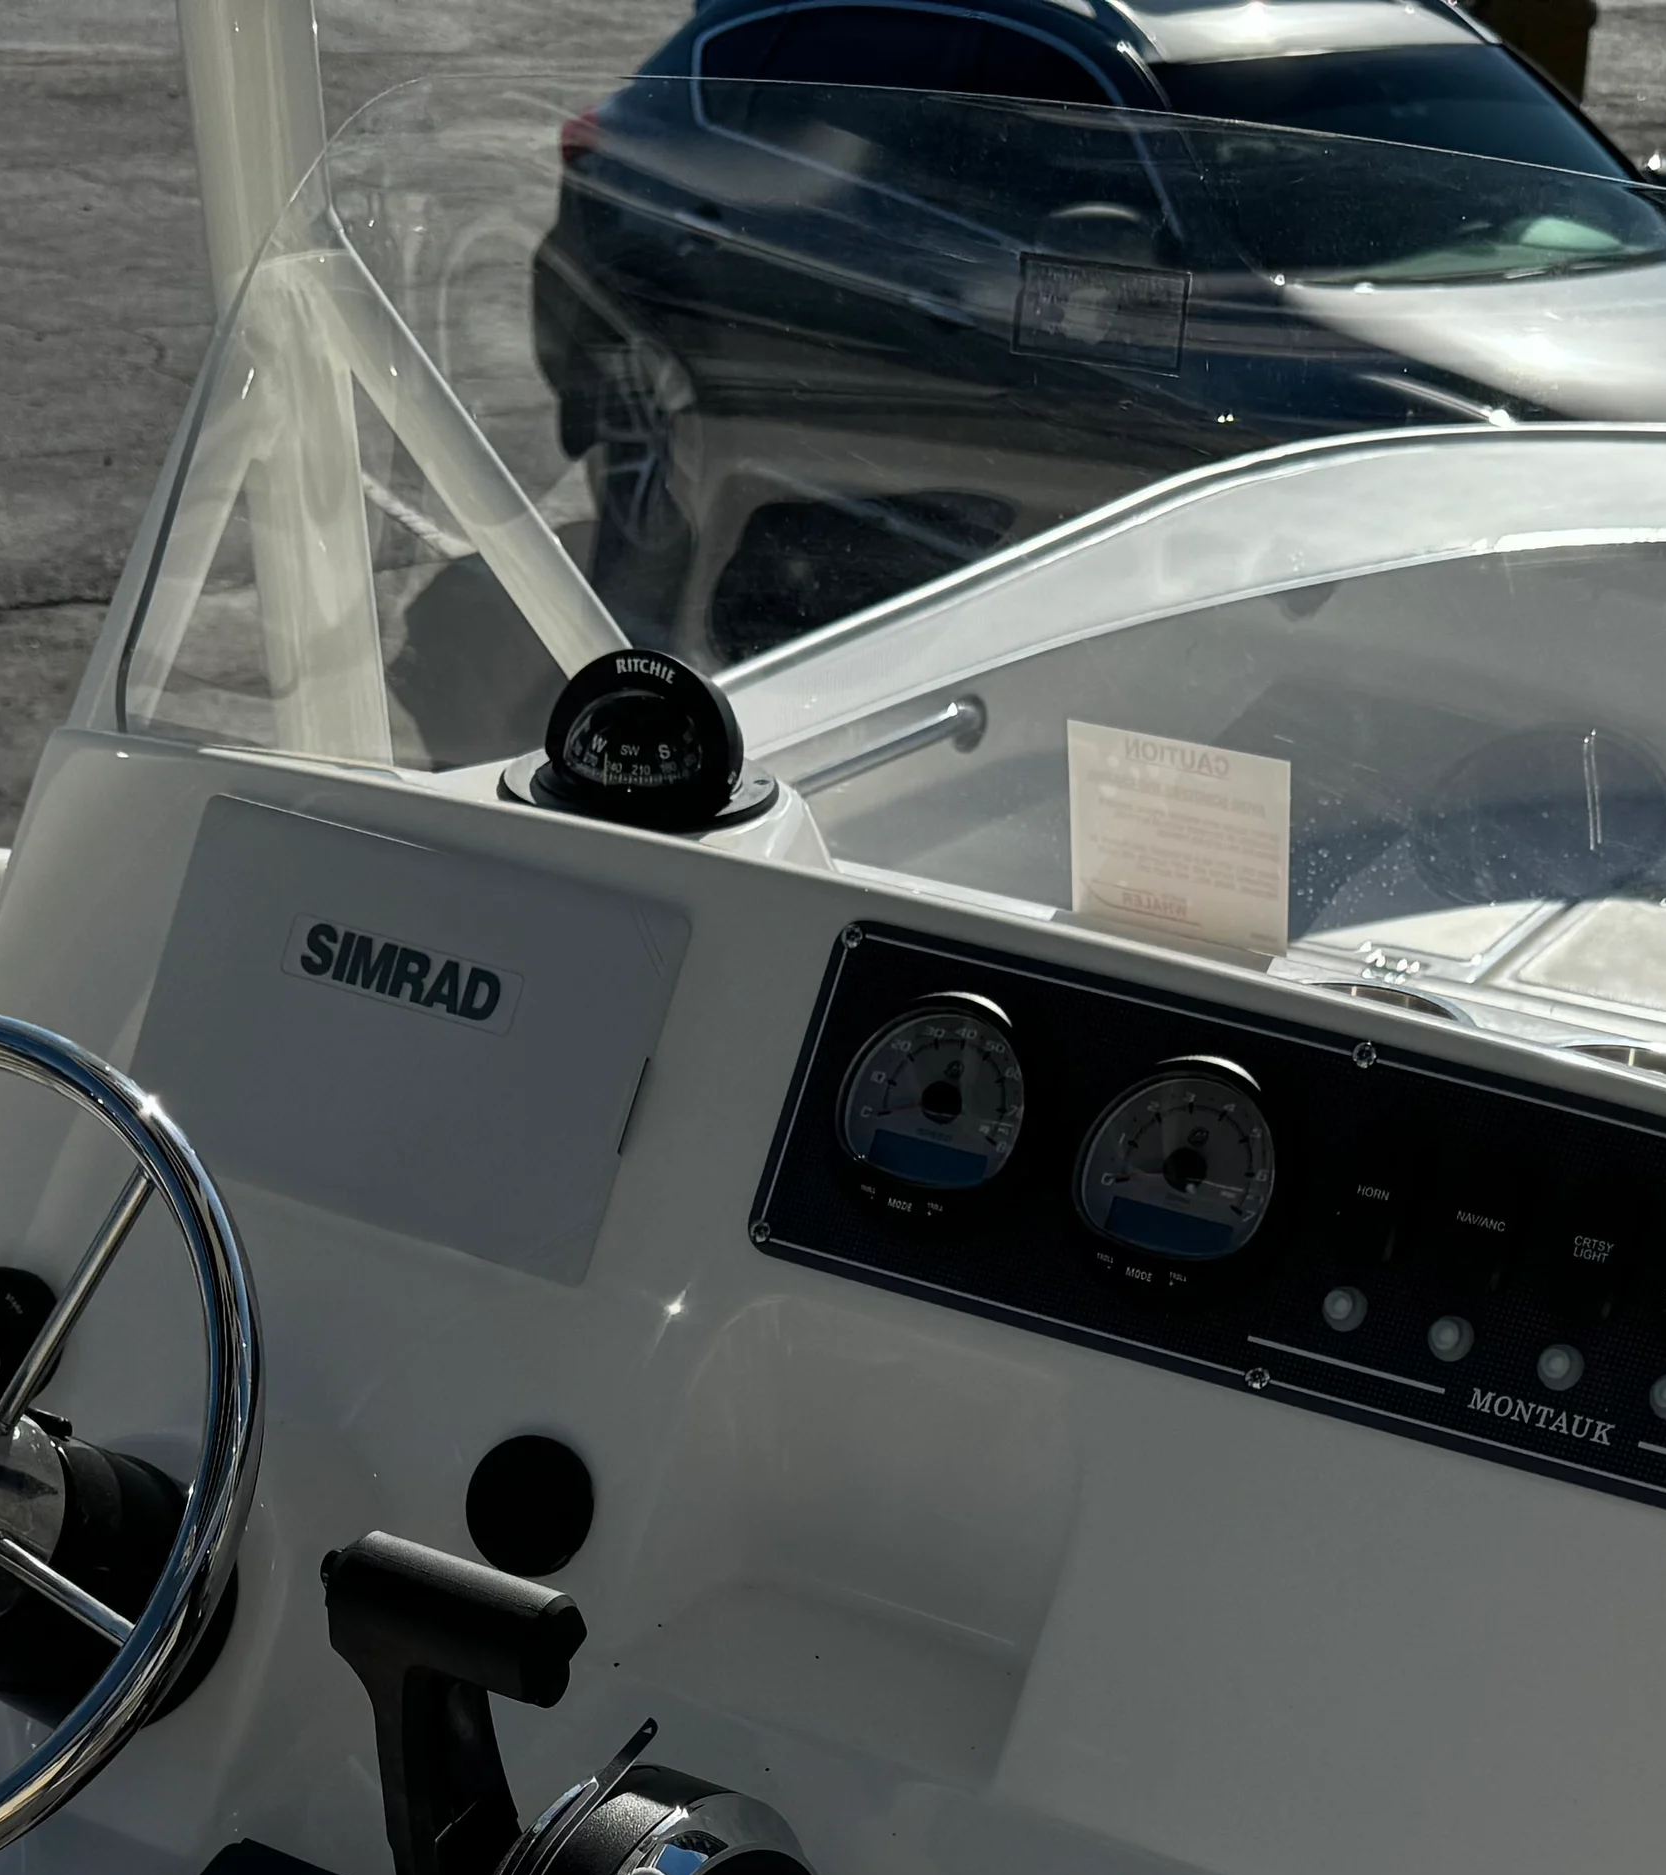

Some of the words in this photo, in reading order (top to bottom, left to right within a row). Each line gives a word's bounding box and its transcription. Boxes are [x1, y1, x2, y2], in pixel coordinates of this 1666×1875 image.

[616, 658, 676, 684] RITCHIE
[592, 734, 608, 754] W
[620, 744, 640, 757] SW
[658, 743, 671, 760] S
[631, 763, 651, 776] 210
[300, 923, 501, 1021] SIMRAD
[954, 1027, 978, 1039] 40
[1356, 1184, 1390, 1202] HORN
[887, 1197, 913, 1213] MODE
[1456, 1209, 1506, 1233] NAV/ANC
[1573, 1244, 1609, 1264] LIGHT
[1574, 1235, 1615, 1254] CRTSY
[1125, 1267, 1153, 1283] MODE
[1467, 1387, 1616, 1446] MONTAUK
